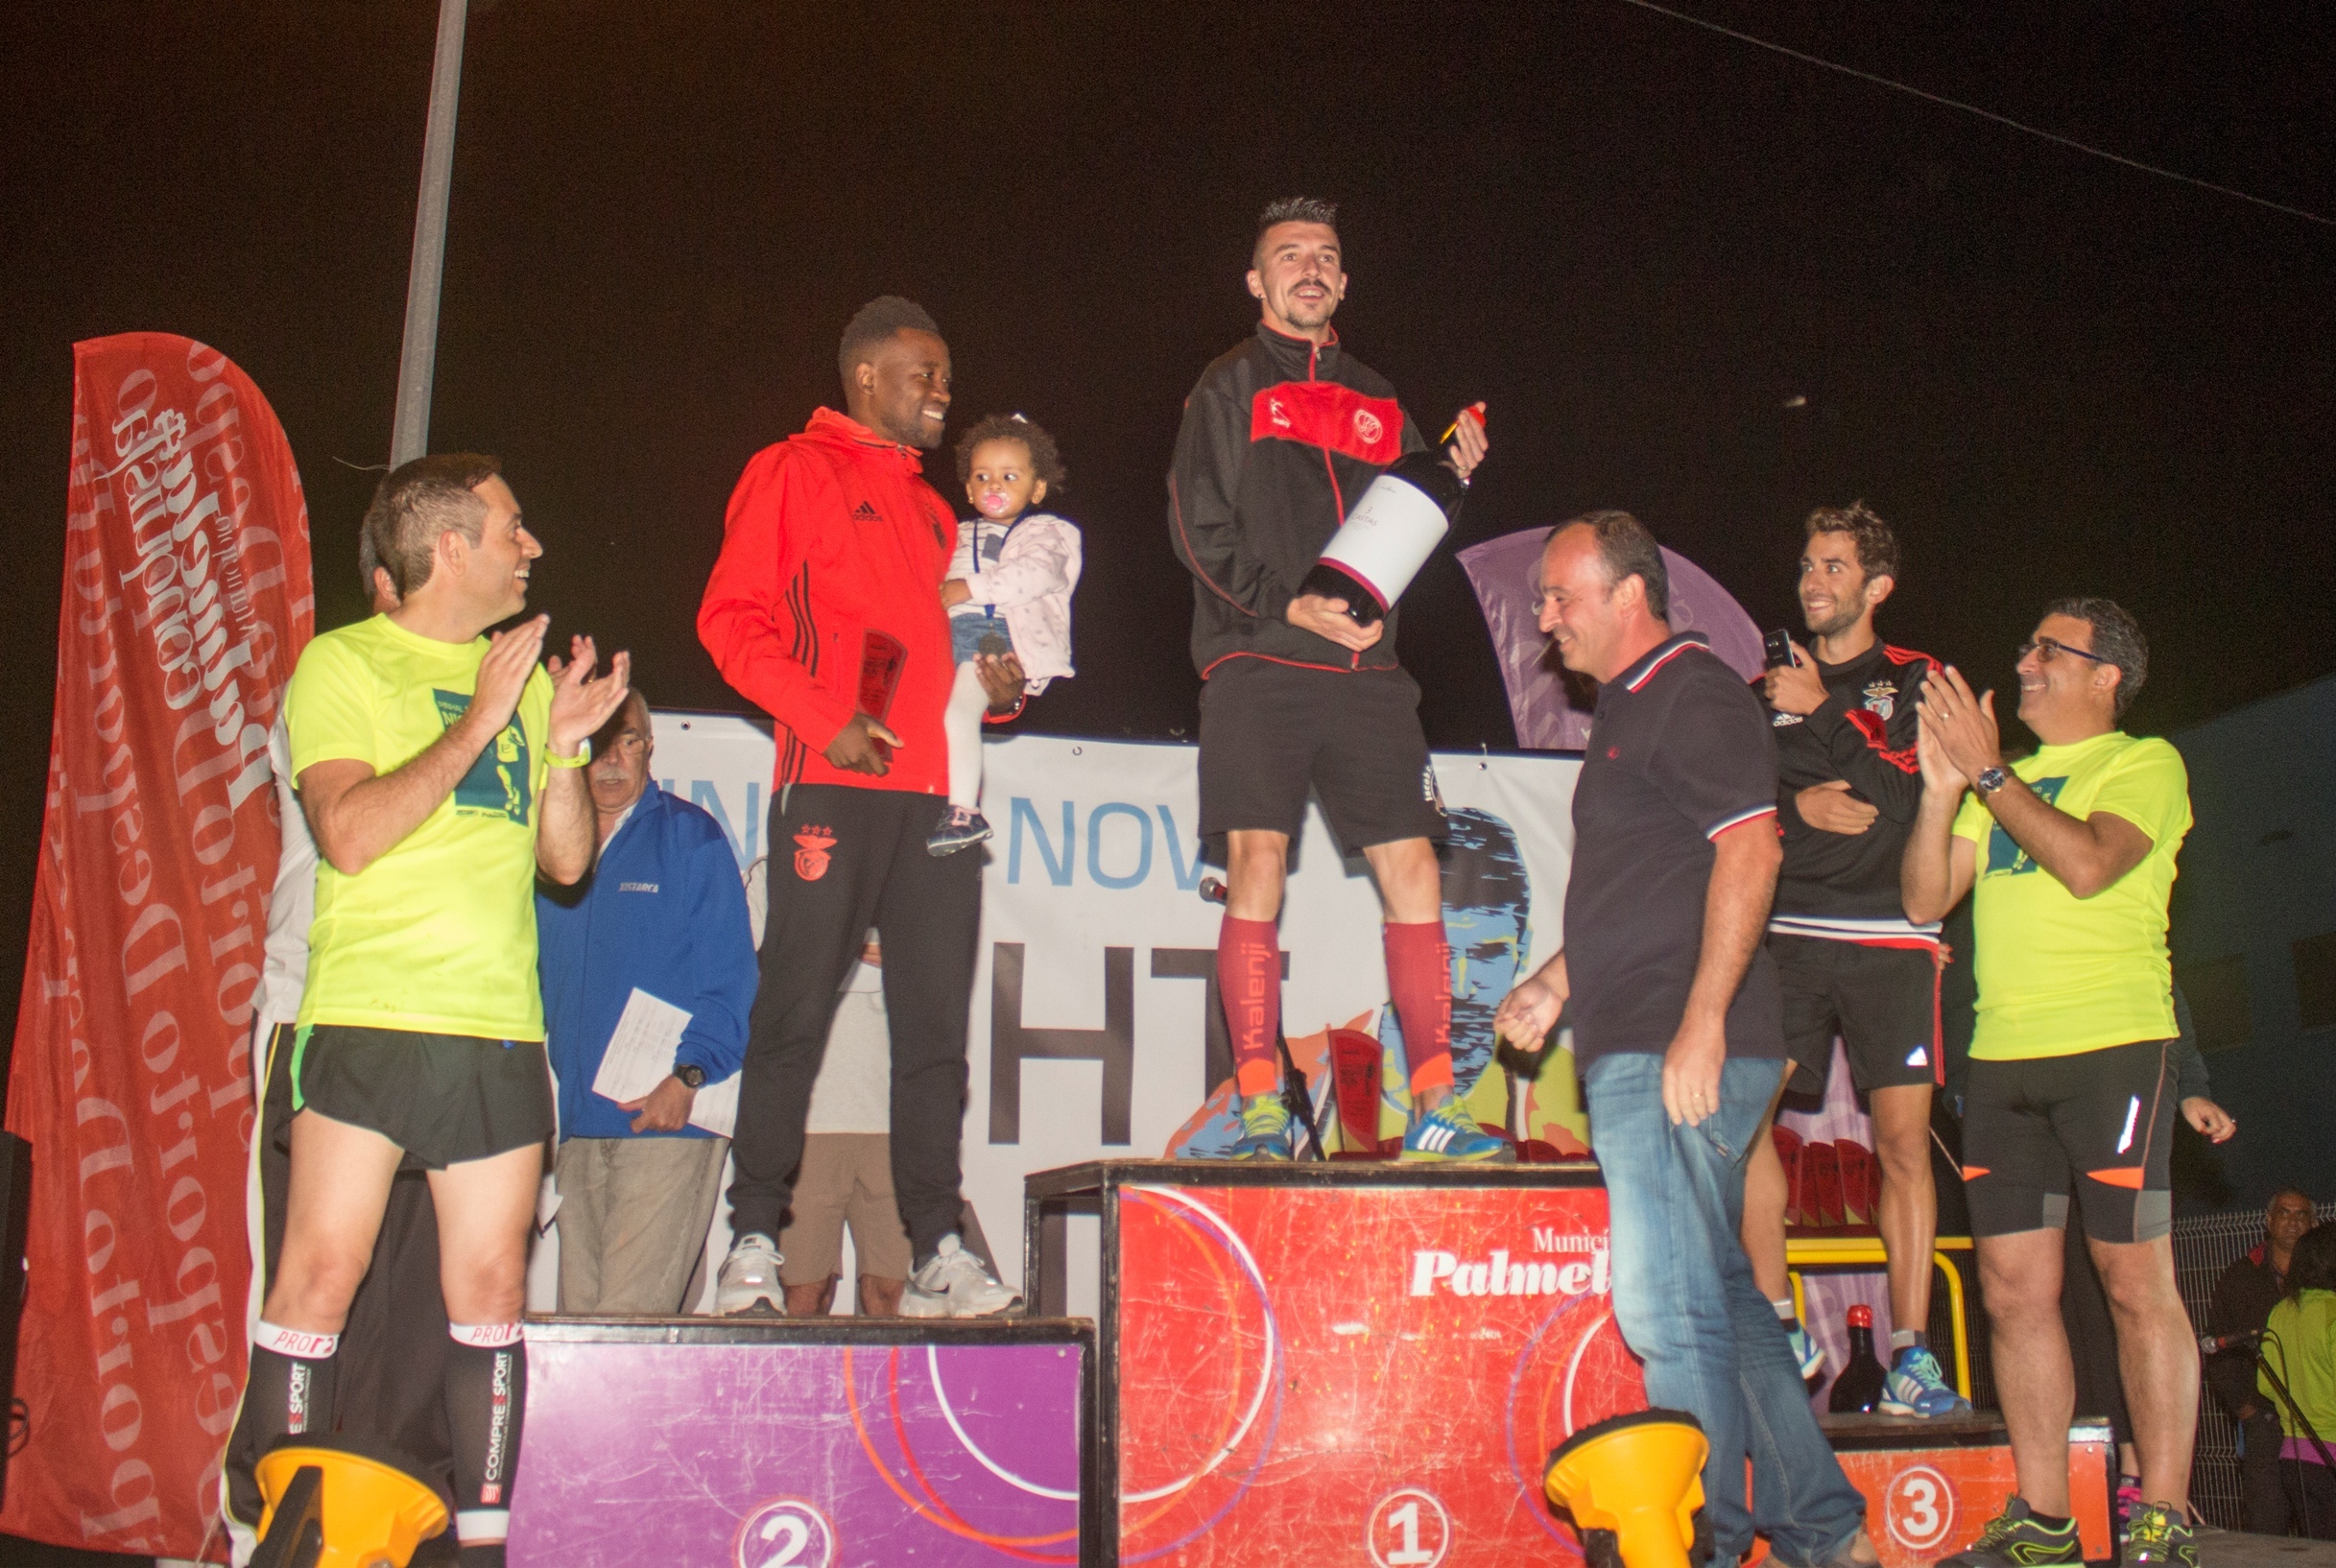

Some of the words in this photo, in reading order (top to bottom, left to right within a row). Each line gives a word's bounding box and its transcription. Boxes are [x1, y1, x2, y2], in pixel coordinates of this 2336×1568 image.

[1773, 716, 1803, 726] adidas
[485, 1351, 508, 1482] COMPRESSPORT
[1387, 1502, 1434, 1565] 1
[1902, 1479, 1939, 1535] 3
[760, 1514, 807, 1568] 2
